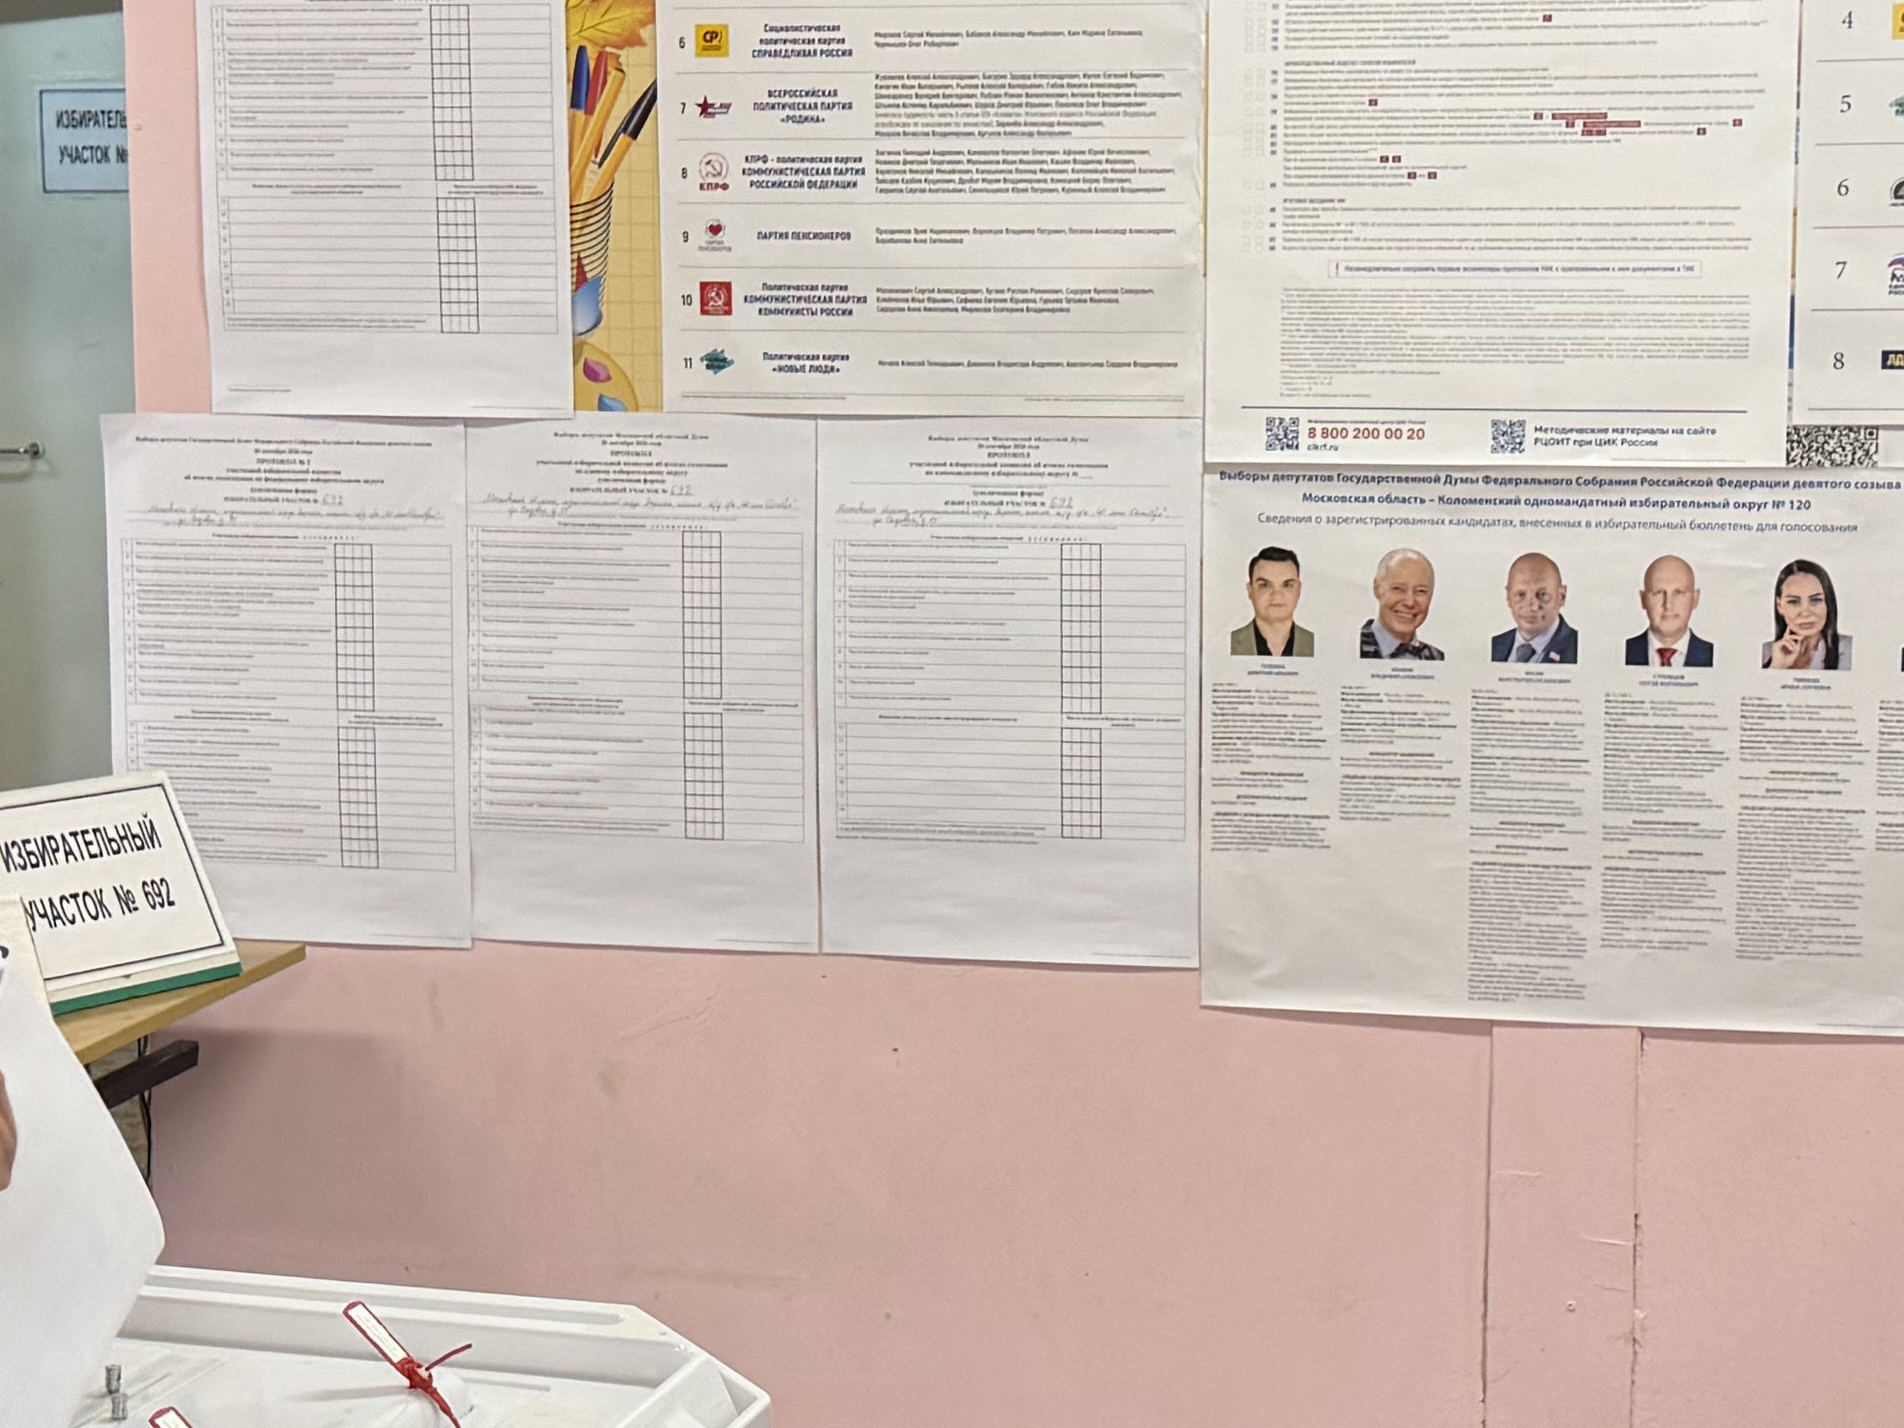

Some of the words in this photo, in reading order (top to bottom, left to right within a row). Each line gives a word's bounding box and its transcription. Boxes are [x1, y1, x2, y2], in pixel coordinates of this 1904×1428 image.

[1841, 11, 1854, 31] 4
[679, 35, 685, 49] 6
[680, 102, 687, 114] 7
[1840, 94, 1852, 114] 5
[59, 145, 111, 164] УЧАСТОК
[681, 167, 688, 179] 8
[1837, 178, 1849, 198] 6
[683, 231, 689, 243] 9
[1836, 260, 1848, 281] 7
[681, 294, 693, 306] 10
[684, 357, 693, 369] 11
[1833, 350, 1844, 371] 8
[1307, 426, 1316, 439] 8
[1320, 426, 1348, 439] 800
[1352, 427, 1380, 439] 200
[1383, 427, 1403, 439] 00
[1406, 427, 1425, 440] 20
[1219, 471, 1269, 482] Выборы
[1271, 473, 1334, 483] депутатов
[1336, 472, 1441, 484] Государственной
[1442, 473, 1479, 486] Думы
[1481, 475, 1573, 486] Федерального
[1575, 475, 1637, 488] Собрания
[1639, 476, 1713, 487] Российской
[1715, 477, 1789, 489] Федерации
[1791, 480, 1851, 489] девятого
[1854, 481, 1901, 489] созыва
[1301, 492, 1375, 503] Московская
[1377, 492, 1426, 504] область
[1437, 494, 1521, 505] Коломенский
[1523, 497, 1626, 508] одномандатный
[1629, 497, 1730, 509] избирательный
[1732, 501, 1768, 511] округ
[1771, 499, 1785, 509] №
[1789, 499, 1811, 510] 120
[26, 888, 110, 932] УЧАСТОК
[117, 888, 137, 916] №
[142, 877, 175, 910] 692
